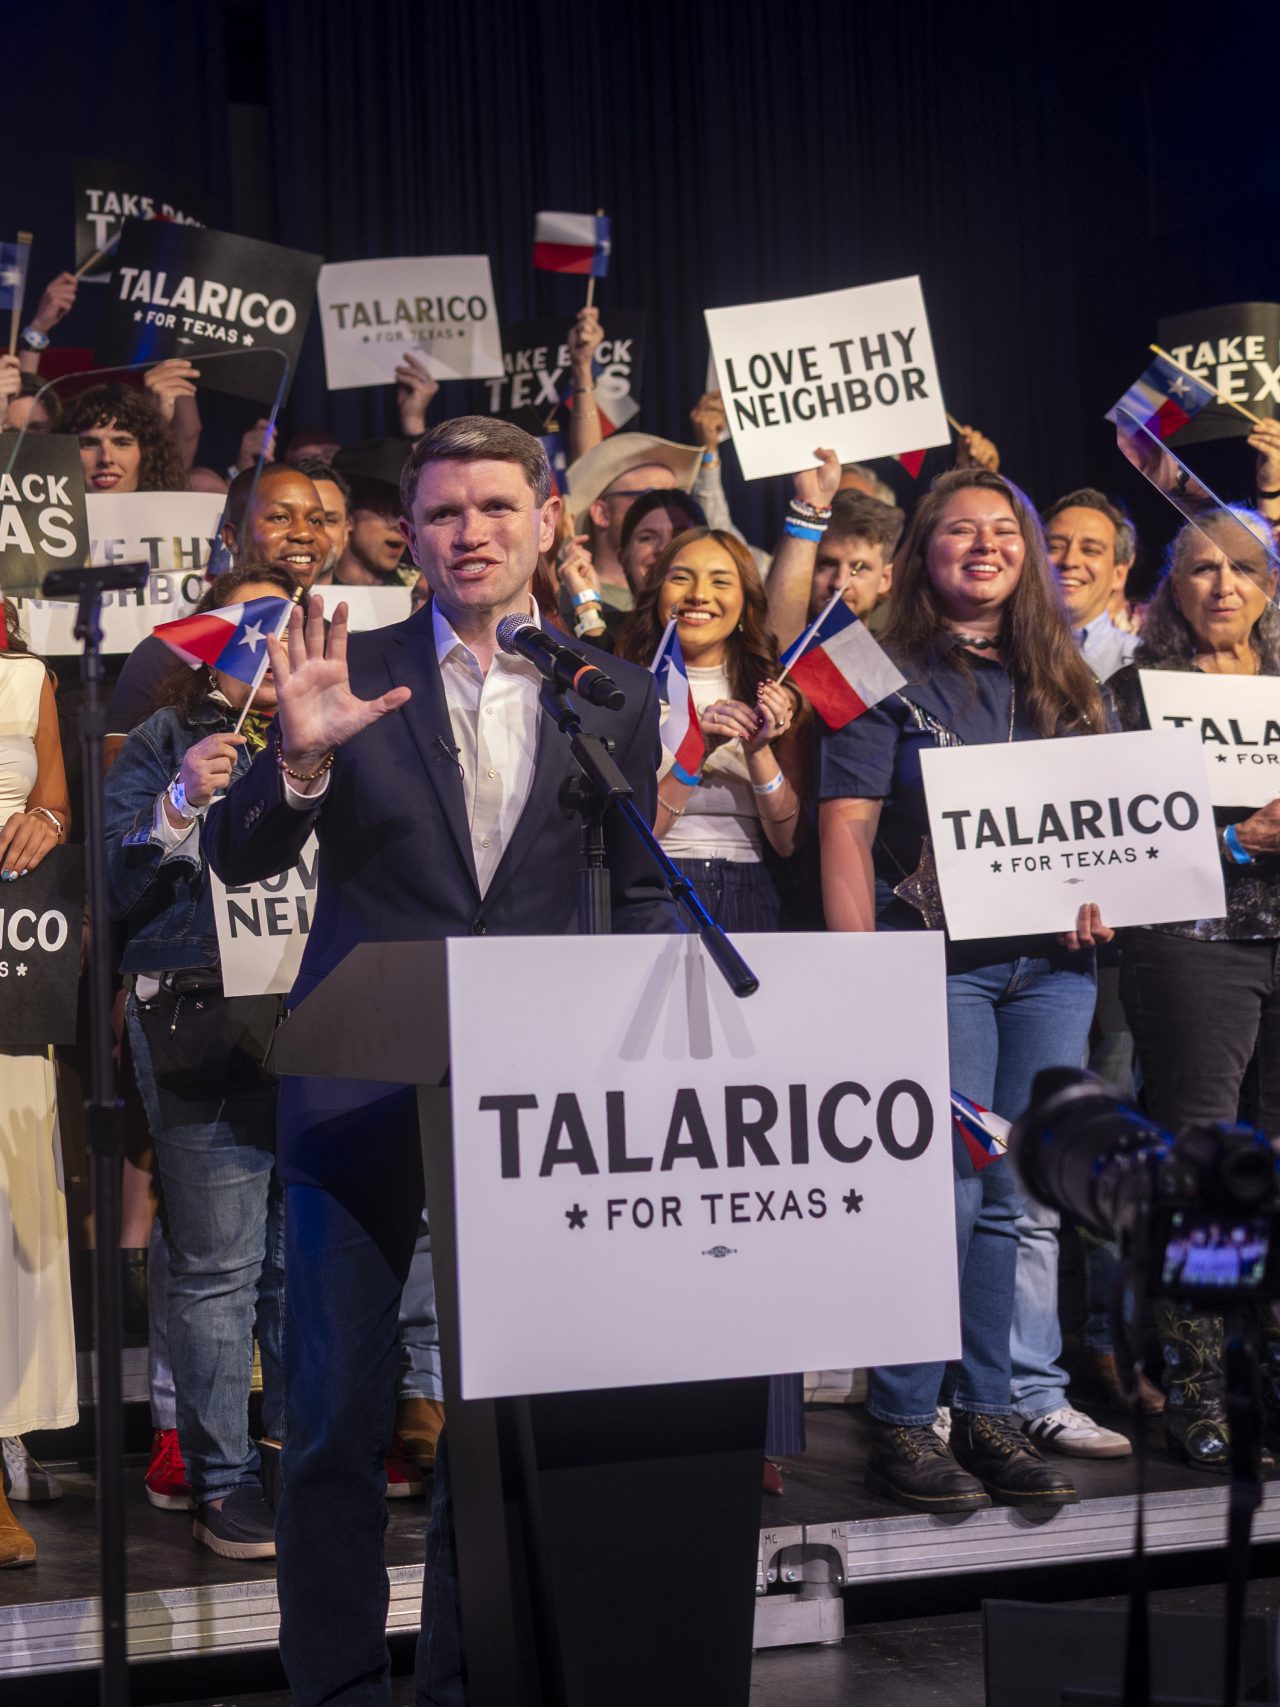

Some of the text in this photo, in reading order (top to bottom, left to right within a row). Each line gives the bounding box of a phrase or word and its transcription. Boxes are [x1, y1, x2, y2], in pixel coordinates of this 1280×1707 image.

[119, 266, 297, 335] TALARICO
[329, 296, 488, 330] TALARICO
[146, 310, 238, 344] FOR TEXAS
[375, 328, 453, 343] FOR TEXAS
[504, 346, 549, 375] AKE
[724, 327, 916, 393] LOVE THY
[1171, 335, 1266, 369] TAKE
[485, 363, 632, 413] TEXS
[733, 367, 929, 431] NEIGHBOR
[1237, 753, 1280, 765] FOR
[941, 790, 1199, 850] TALARICO
[1011, 847, 1137, 873] FOR TEXAS
[478, 1078, 934, 1179] TALARICO
[606, 1187, 829, 1230] FOR TEXAS
[831, 1527, 846, 1539] ML
